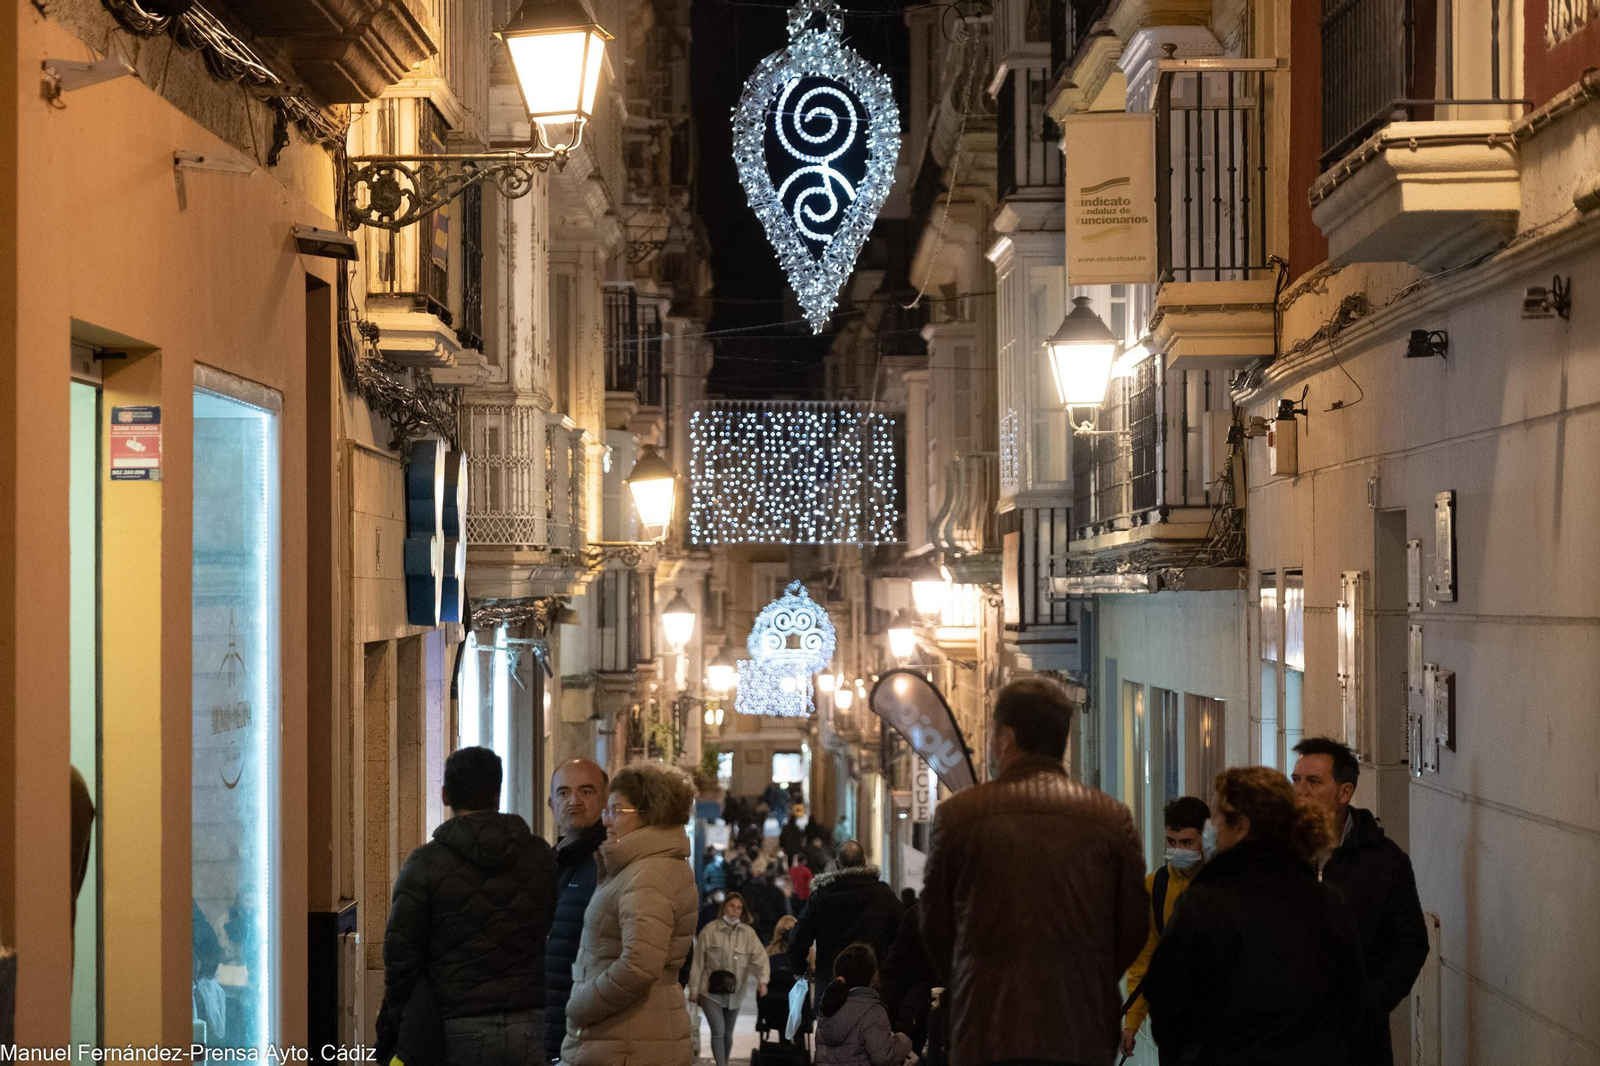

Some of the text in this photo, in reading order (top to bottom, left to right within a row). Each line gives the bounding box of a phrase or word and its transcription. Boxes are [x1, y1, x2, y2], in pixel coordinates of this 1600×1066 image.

[1073, 197, 1131, 207] sindicato
[1075, 214, 1149, 225] funcionarios
[1078, 255, 1147, 263] www.sindicatosaf.es
